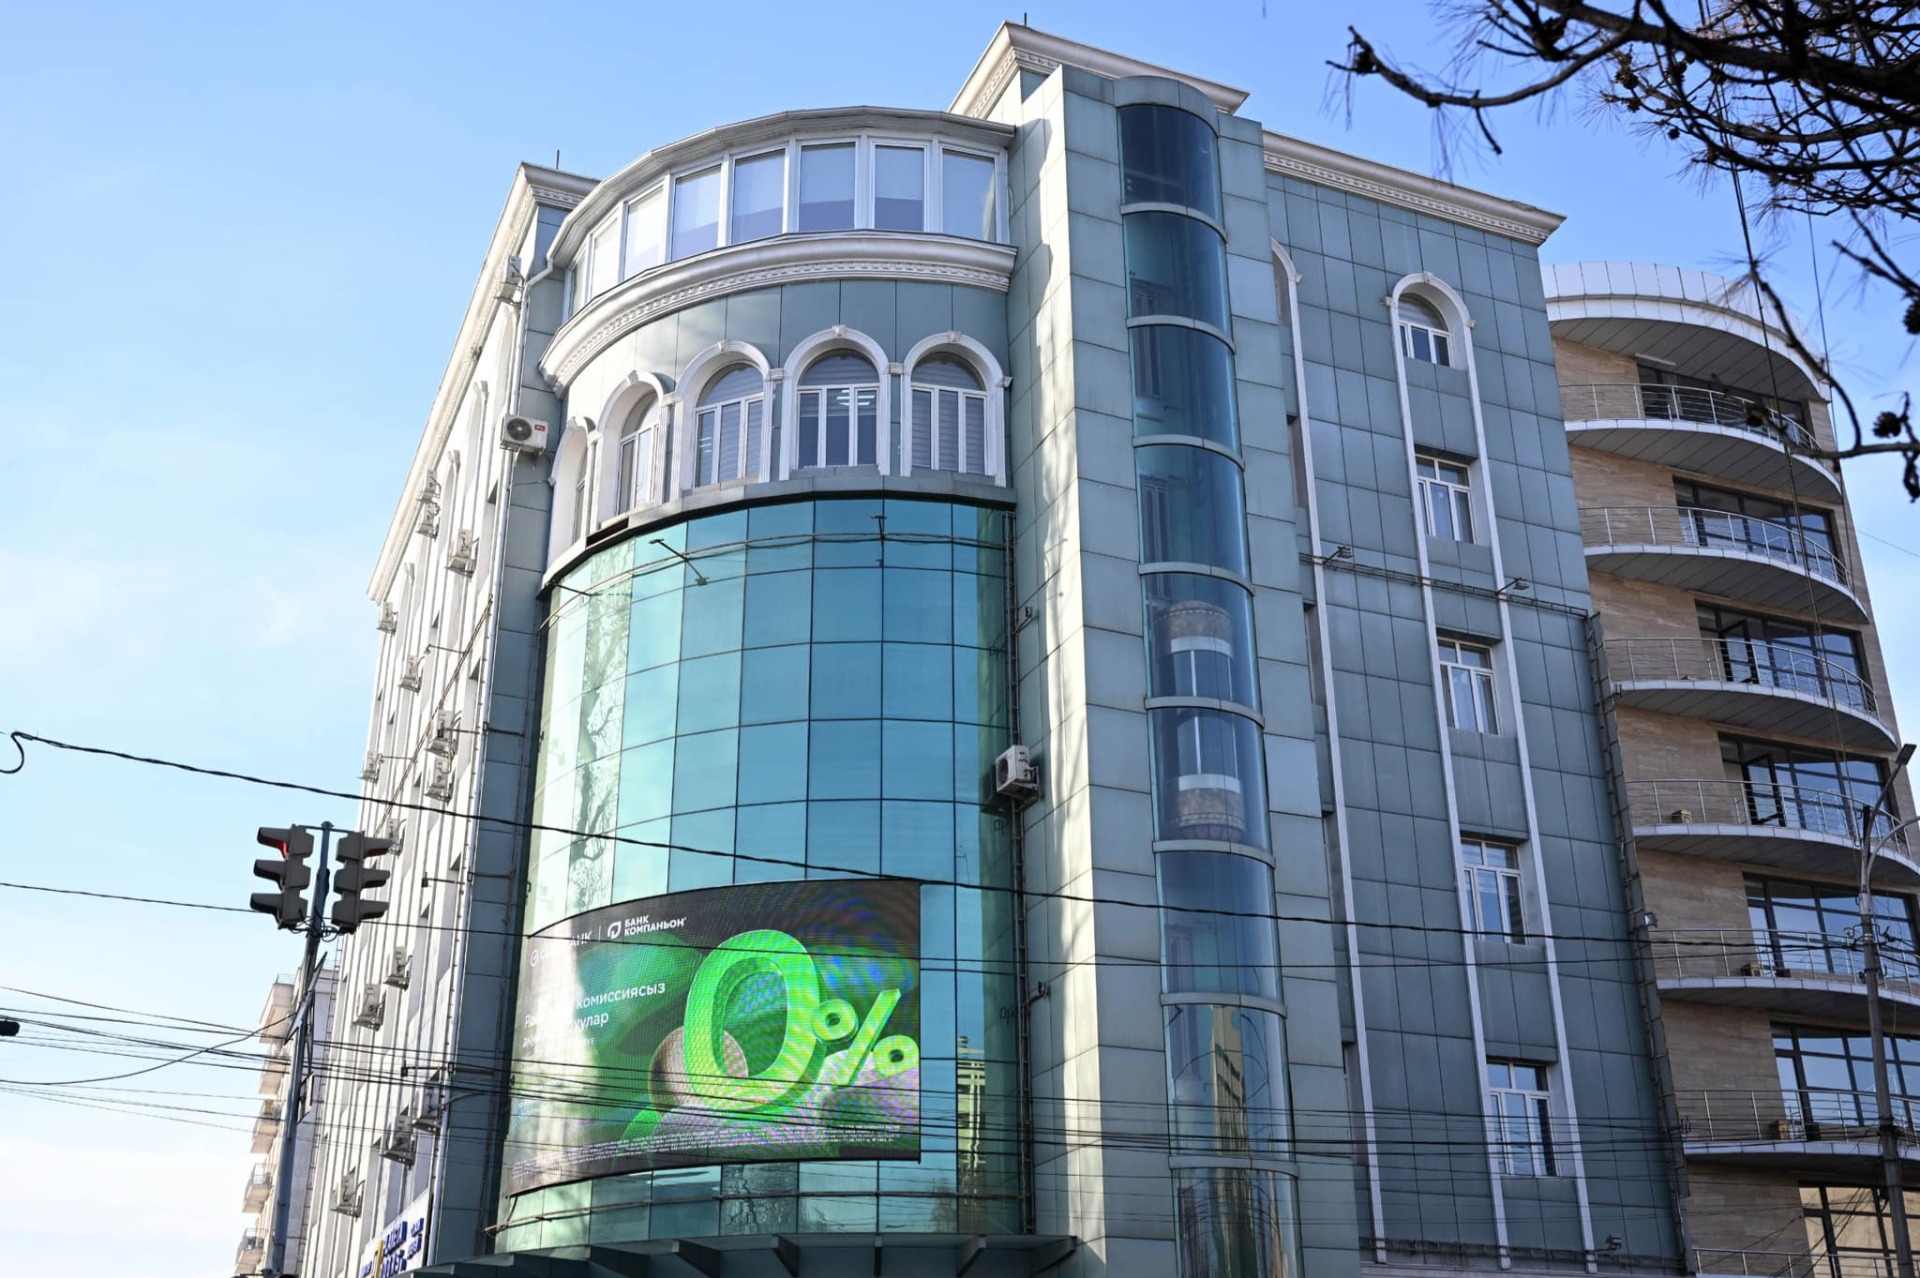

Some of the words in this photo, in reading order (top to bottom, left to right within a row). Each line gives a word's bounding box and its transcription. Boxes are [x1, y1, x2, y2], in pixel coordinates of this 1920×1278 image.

[624, 914, 650, 928] БАНК
[624, 918, 685, 937] КОМПАНЬОН
[576, 982, 666, 1010] комиссиясыз
[683, 929, 920, 1112] 0%
